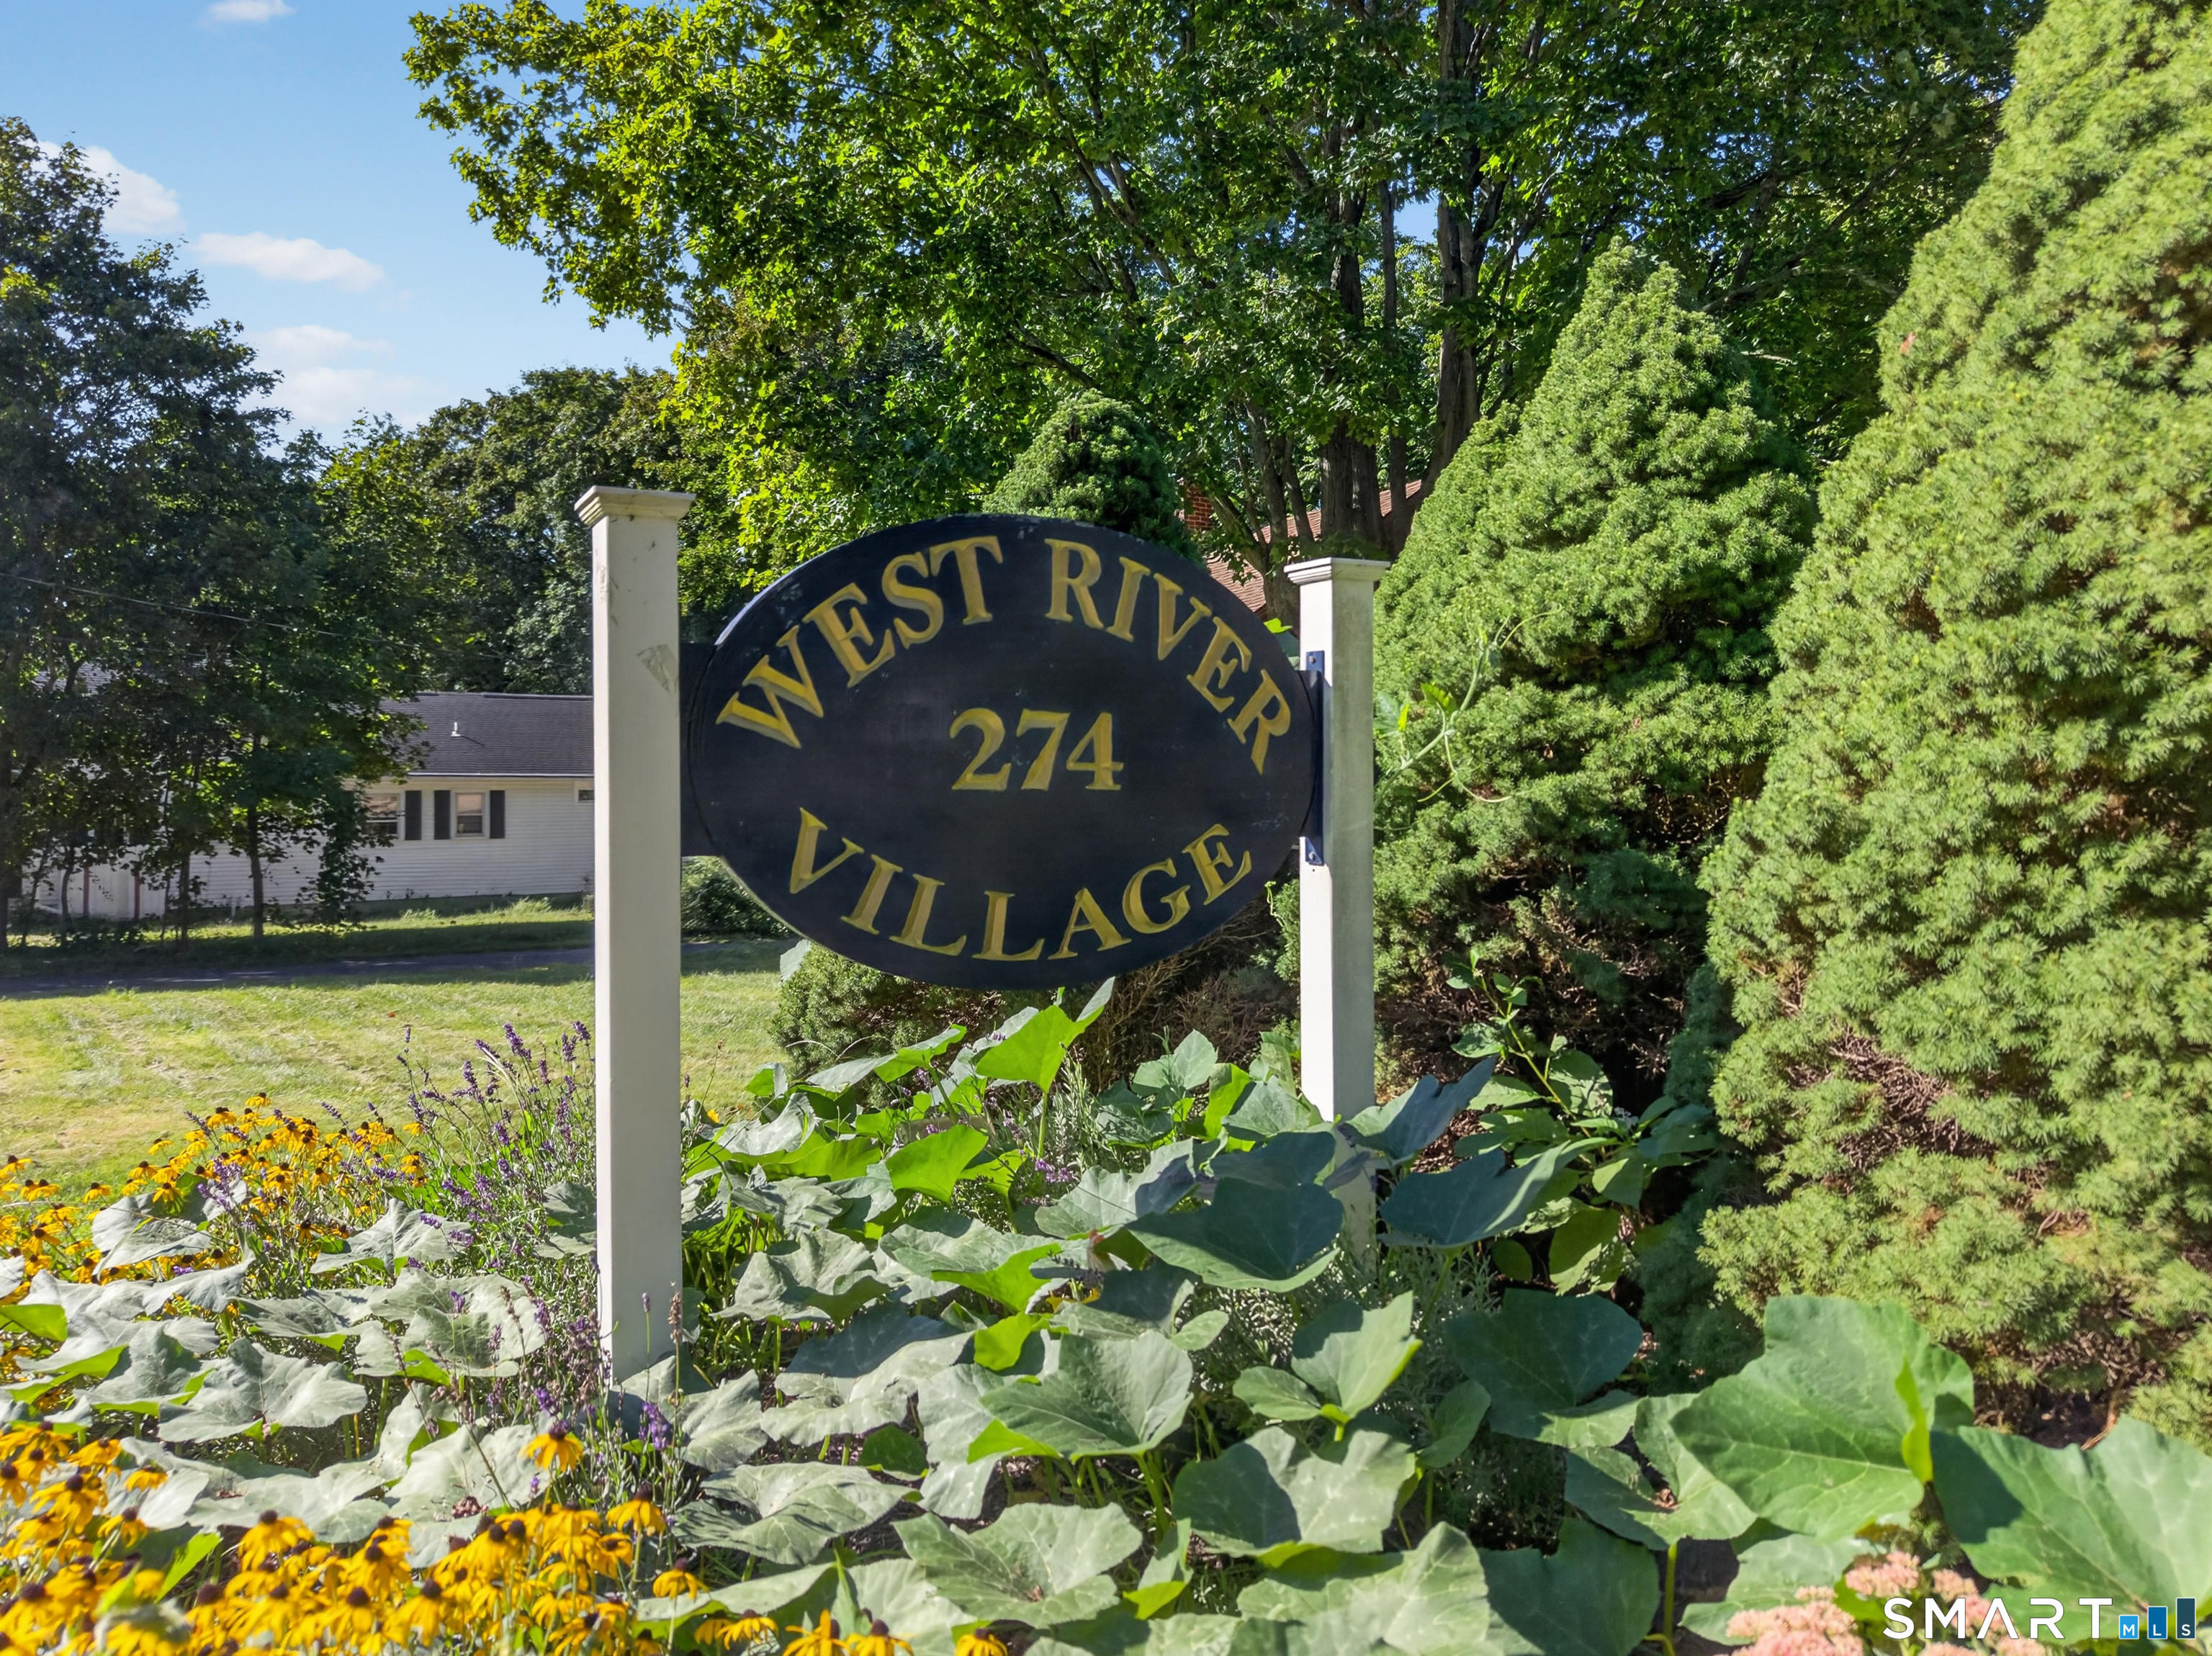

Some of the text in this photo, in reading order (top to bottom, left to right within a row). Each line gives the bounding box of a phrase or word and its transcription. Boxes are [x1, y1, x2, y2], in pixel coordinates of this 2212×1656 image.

[716, 536, 1292, 775] WEST RIVER
[949, 708, 1124, 791] 274
[789, 807, 1253, 961] VILLAGE
